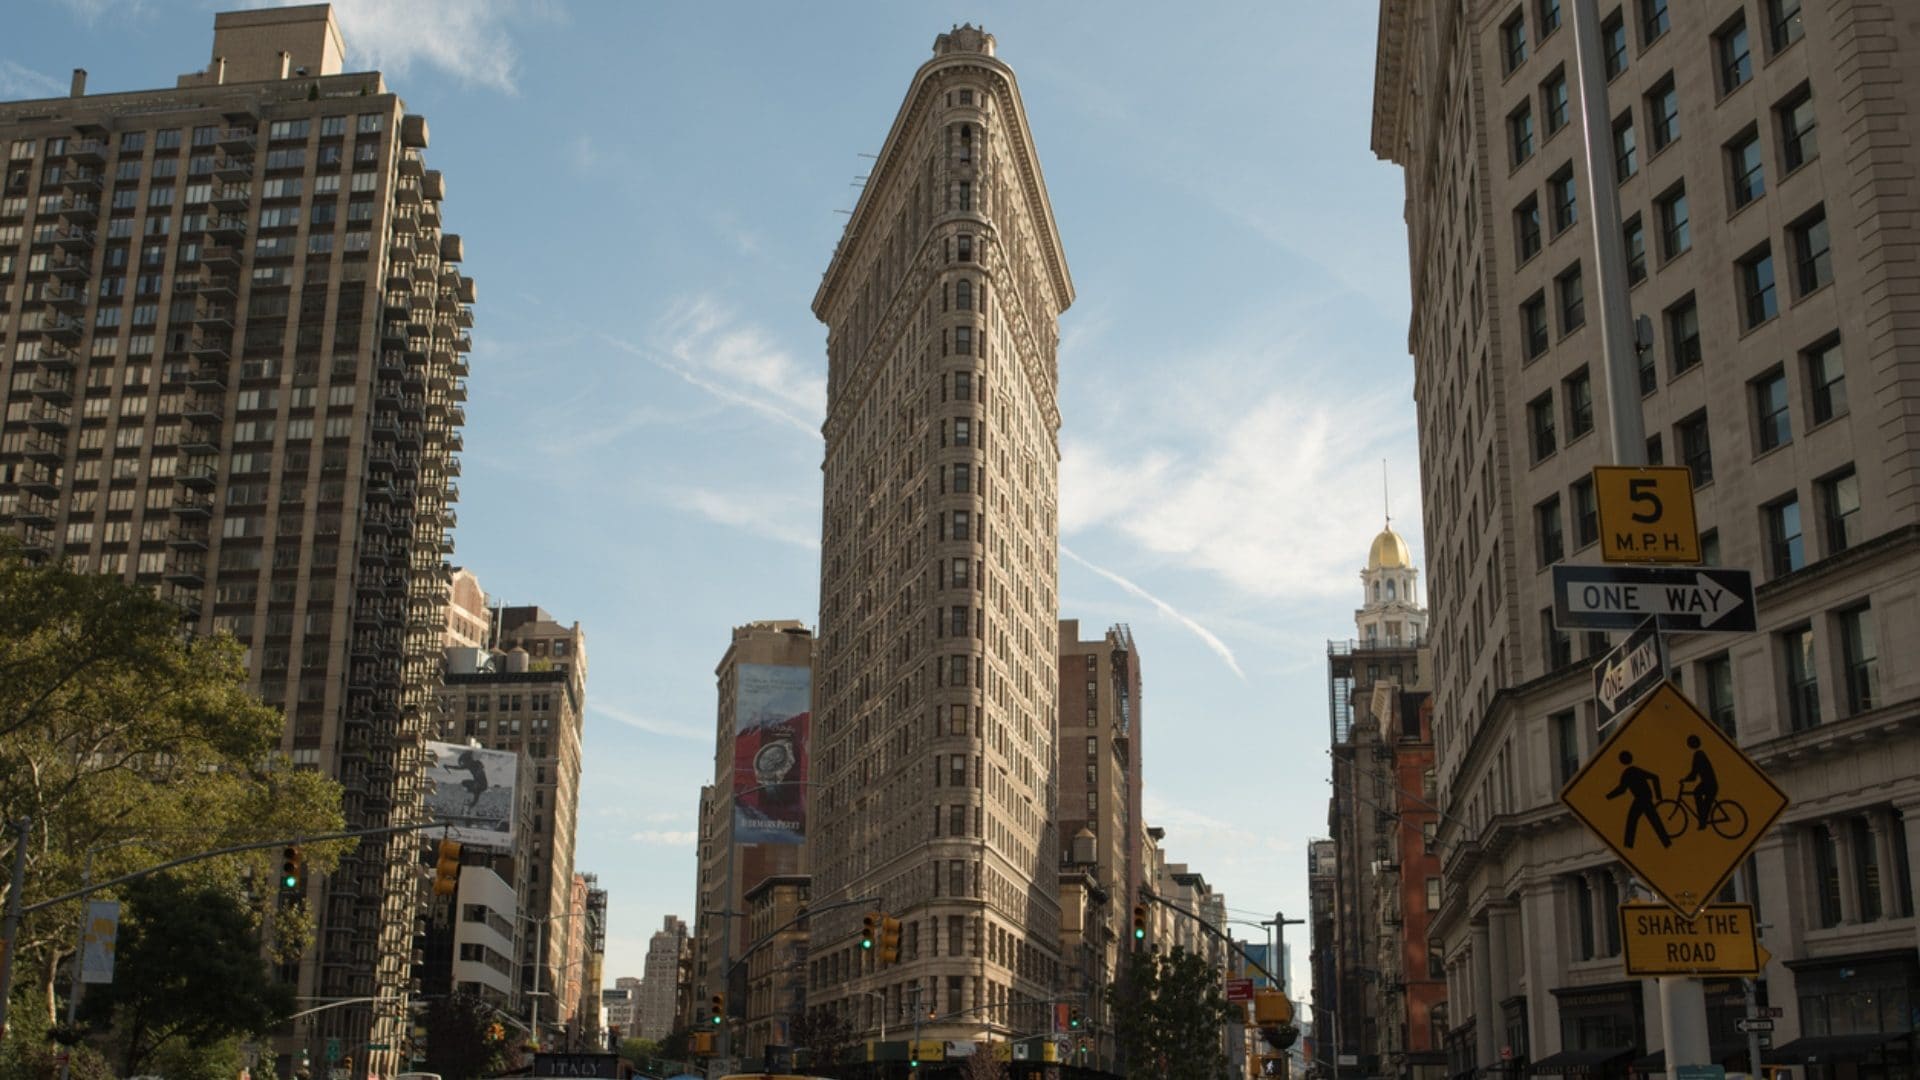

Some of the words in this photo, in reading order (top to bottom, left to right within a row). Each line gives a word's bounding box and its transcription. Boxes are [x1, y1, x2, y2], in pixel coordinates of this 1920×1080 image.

[1629, 479, 1663, 524] 5
[1616, 532, 1685, 552] M.P.H.
[1583, 585, 1640, 610] ONE
[1665, 587, 1723, 612] WAY
[1604, 667, 1624, 701] ONE
[1630, 645, 1652, 680] WAY
[1637, 915, 1697, 935] SHARE
[1704, 915, 1740, 935] THE
[1667, 942, 1716, 962] ROAD
[550, 1063, 601, 1075] ITALY
